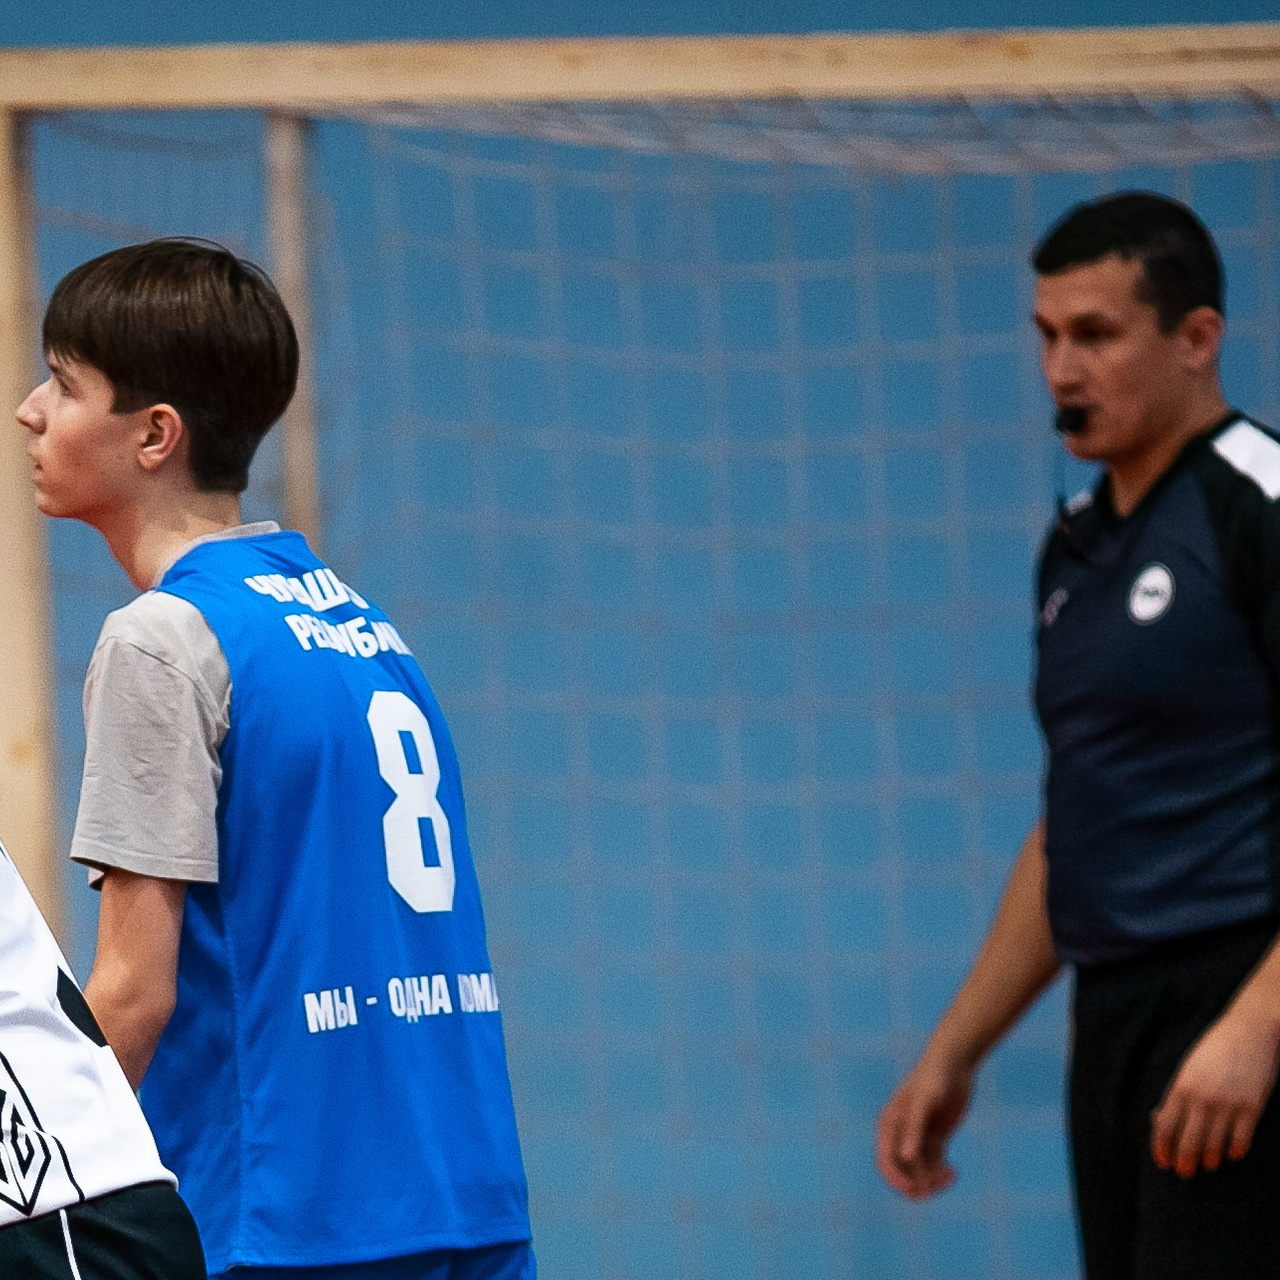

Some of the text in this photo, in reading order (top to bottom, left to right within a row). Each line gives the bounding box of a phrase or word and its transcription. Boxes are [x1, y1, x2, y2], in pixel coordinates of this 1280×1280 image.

[367, 690, 455, 913] 8
[304, 986, 358, 1034] МЫ
[388, 974, 453, 1023] ОДНА
